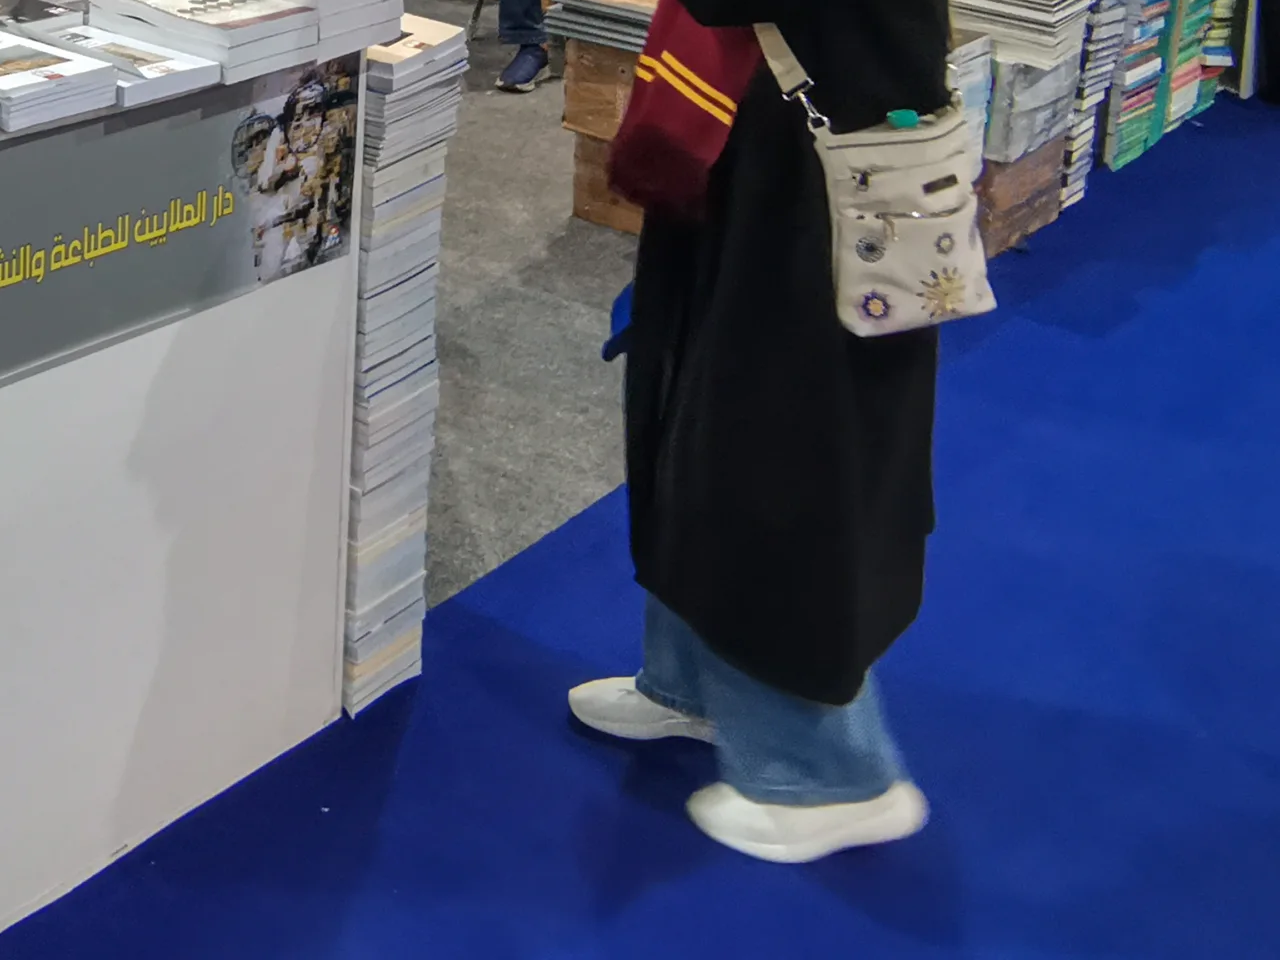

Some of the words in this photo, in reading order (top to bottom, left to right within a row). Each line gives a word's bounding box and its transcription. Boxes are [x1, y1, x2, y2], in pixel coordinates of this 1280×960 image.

[133, 189, 208, 247] الملايين
[209, 184, 235, 227] دار
[48, 213, 130, 272] للطباعة
